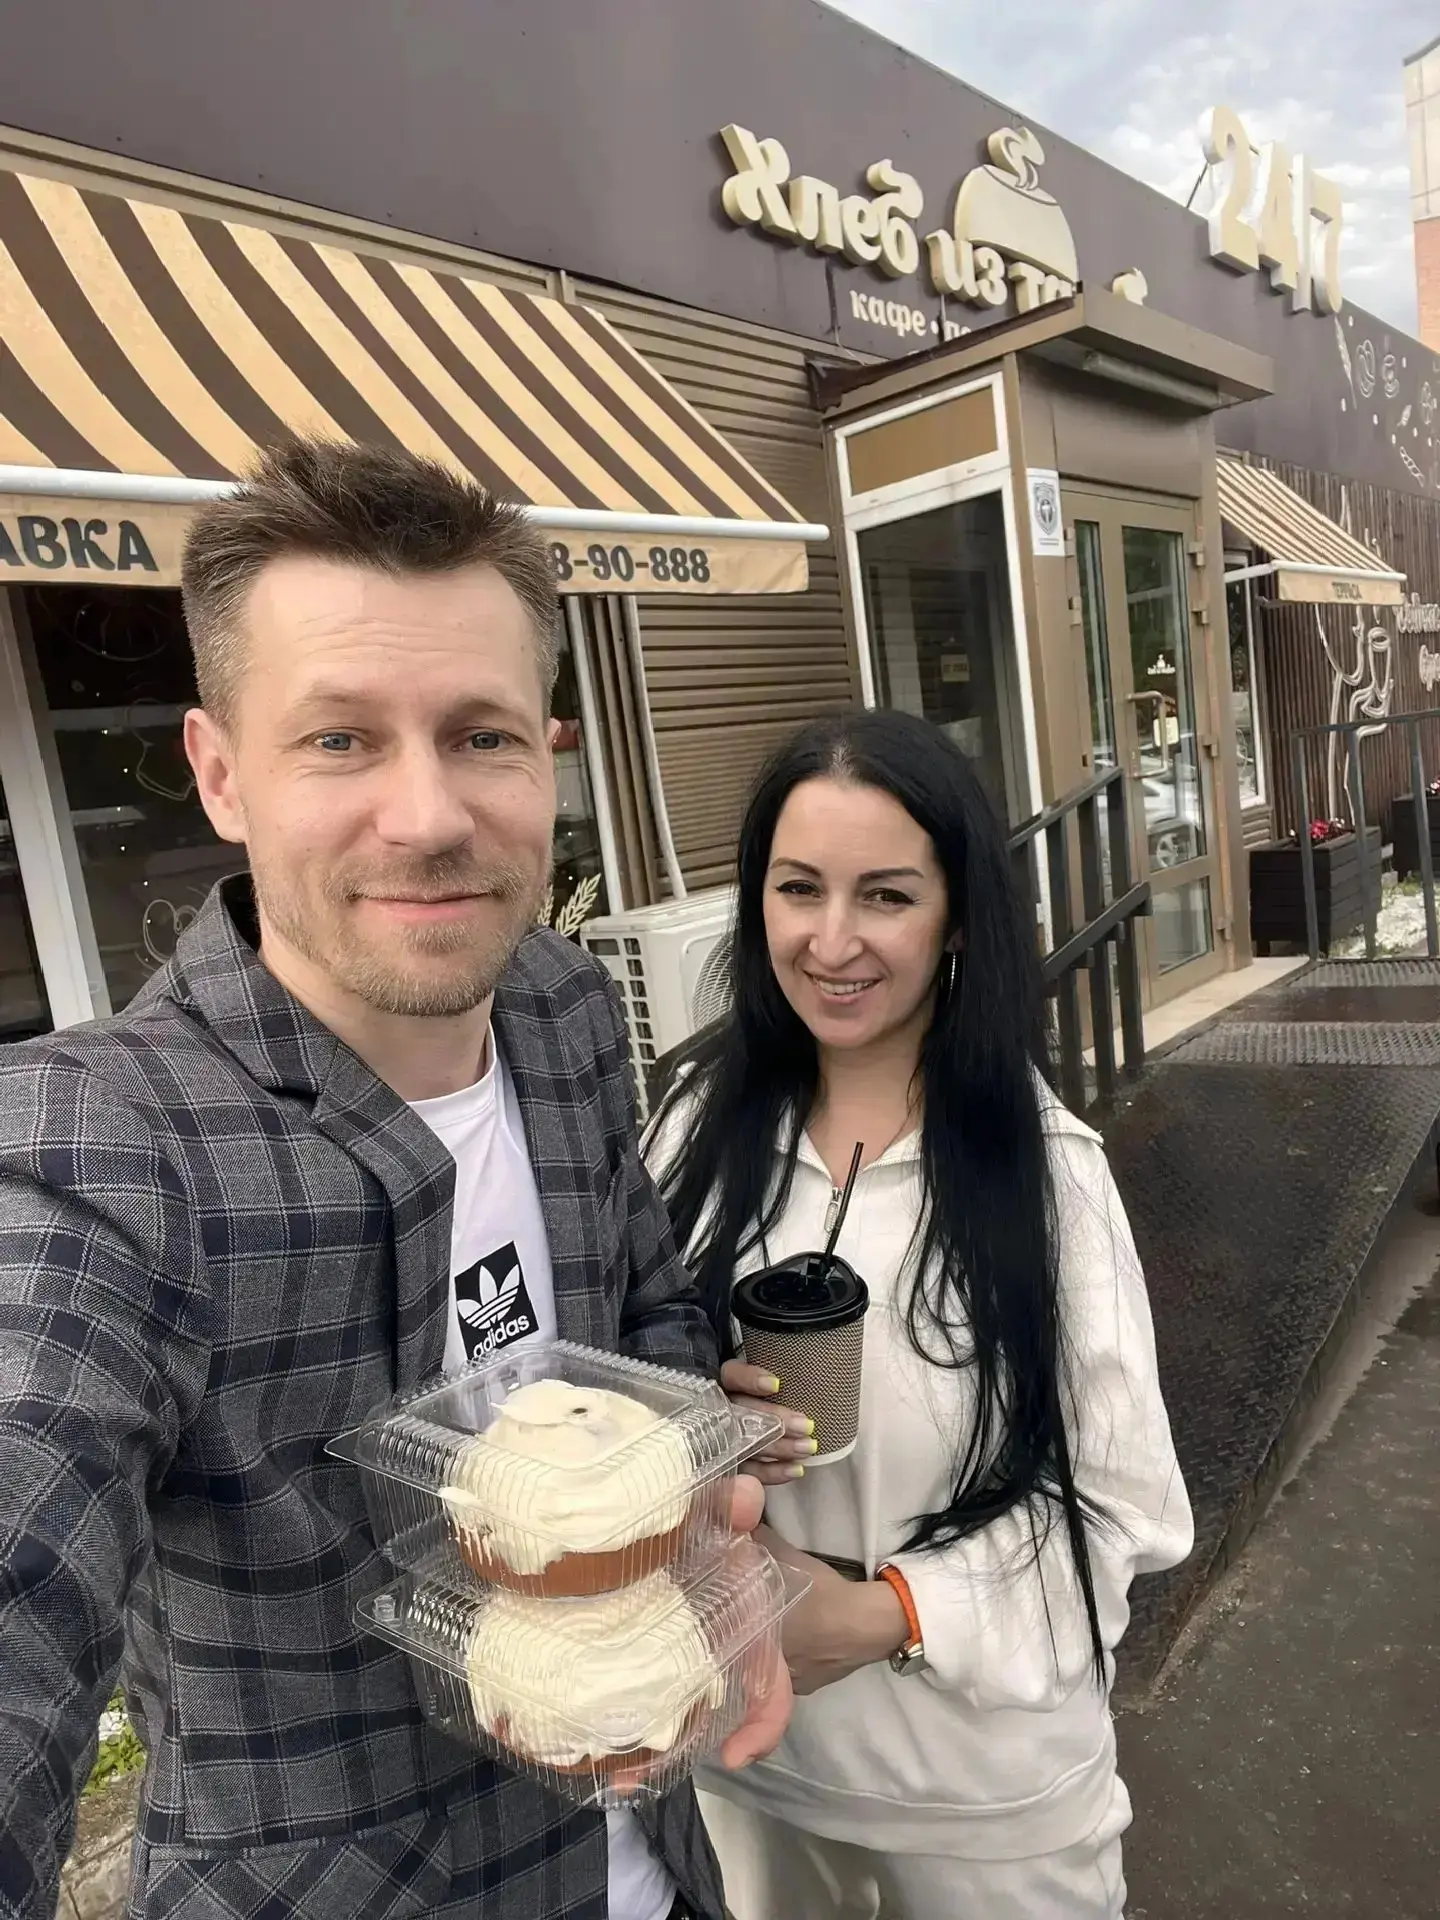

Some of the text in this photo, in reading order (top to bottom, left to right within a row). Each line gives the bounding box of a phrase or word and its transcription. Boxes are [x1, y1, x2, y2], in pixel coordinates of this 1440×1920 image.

[720, 123, 924, 277] Хлеб
[925, 229, 1008, 307] из
[849, 290, 927, 337] кафе
[473, 1315, 530, 1357] adidas
